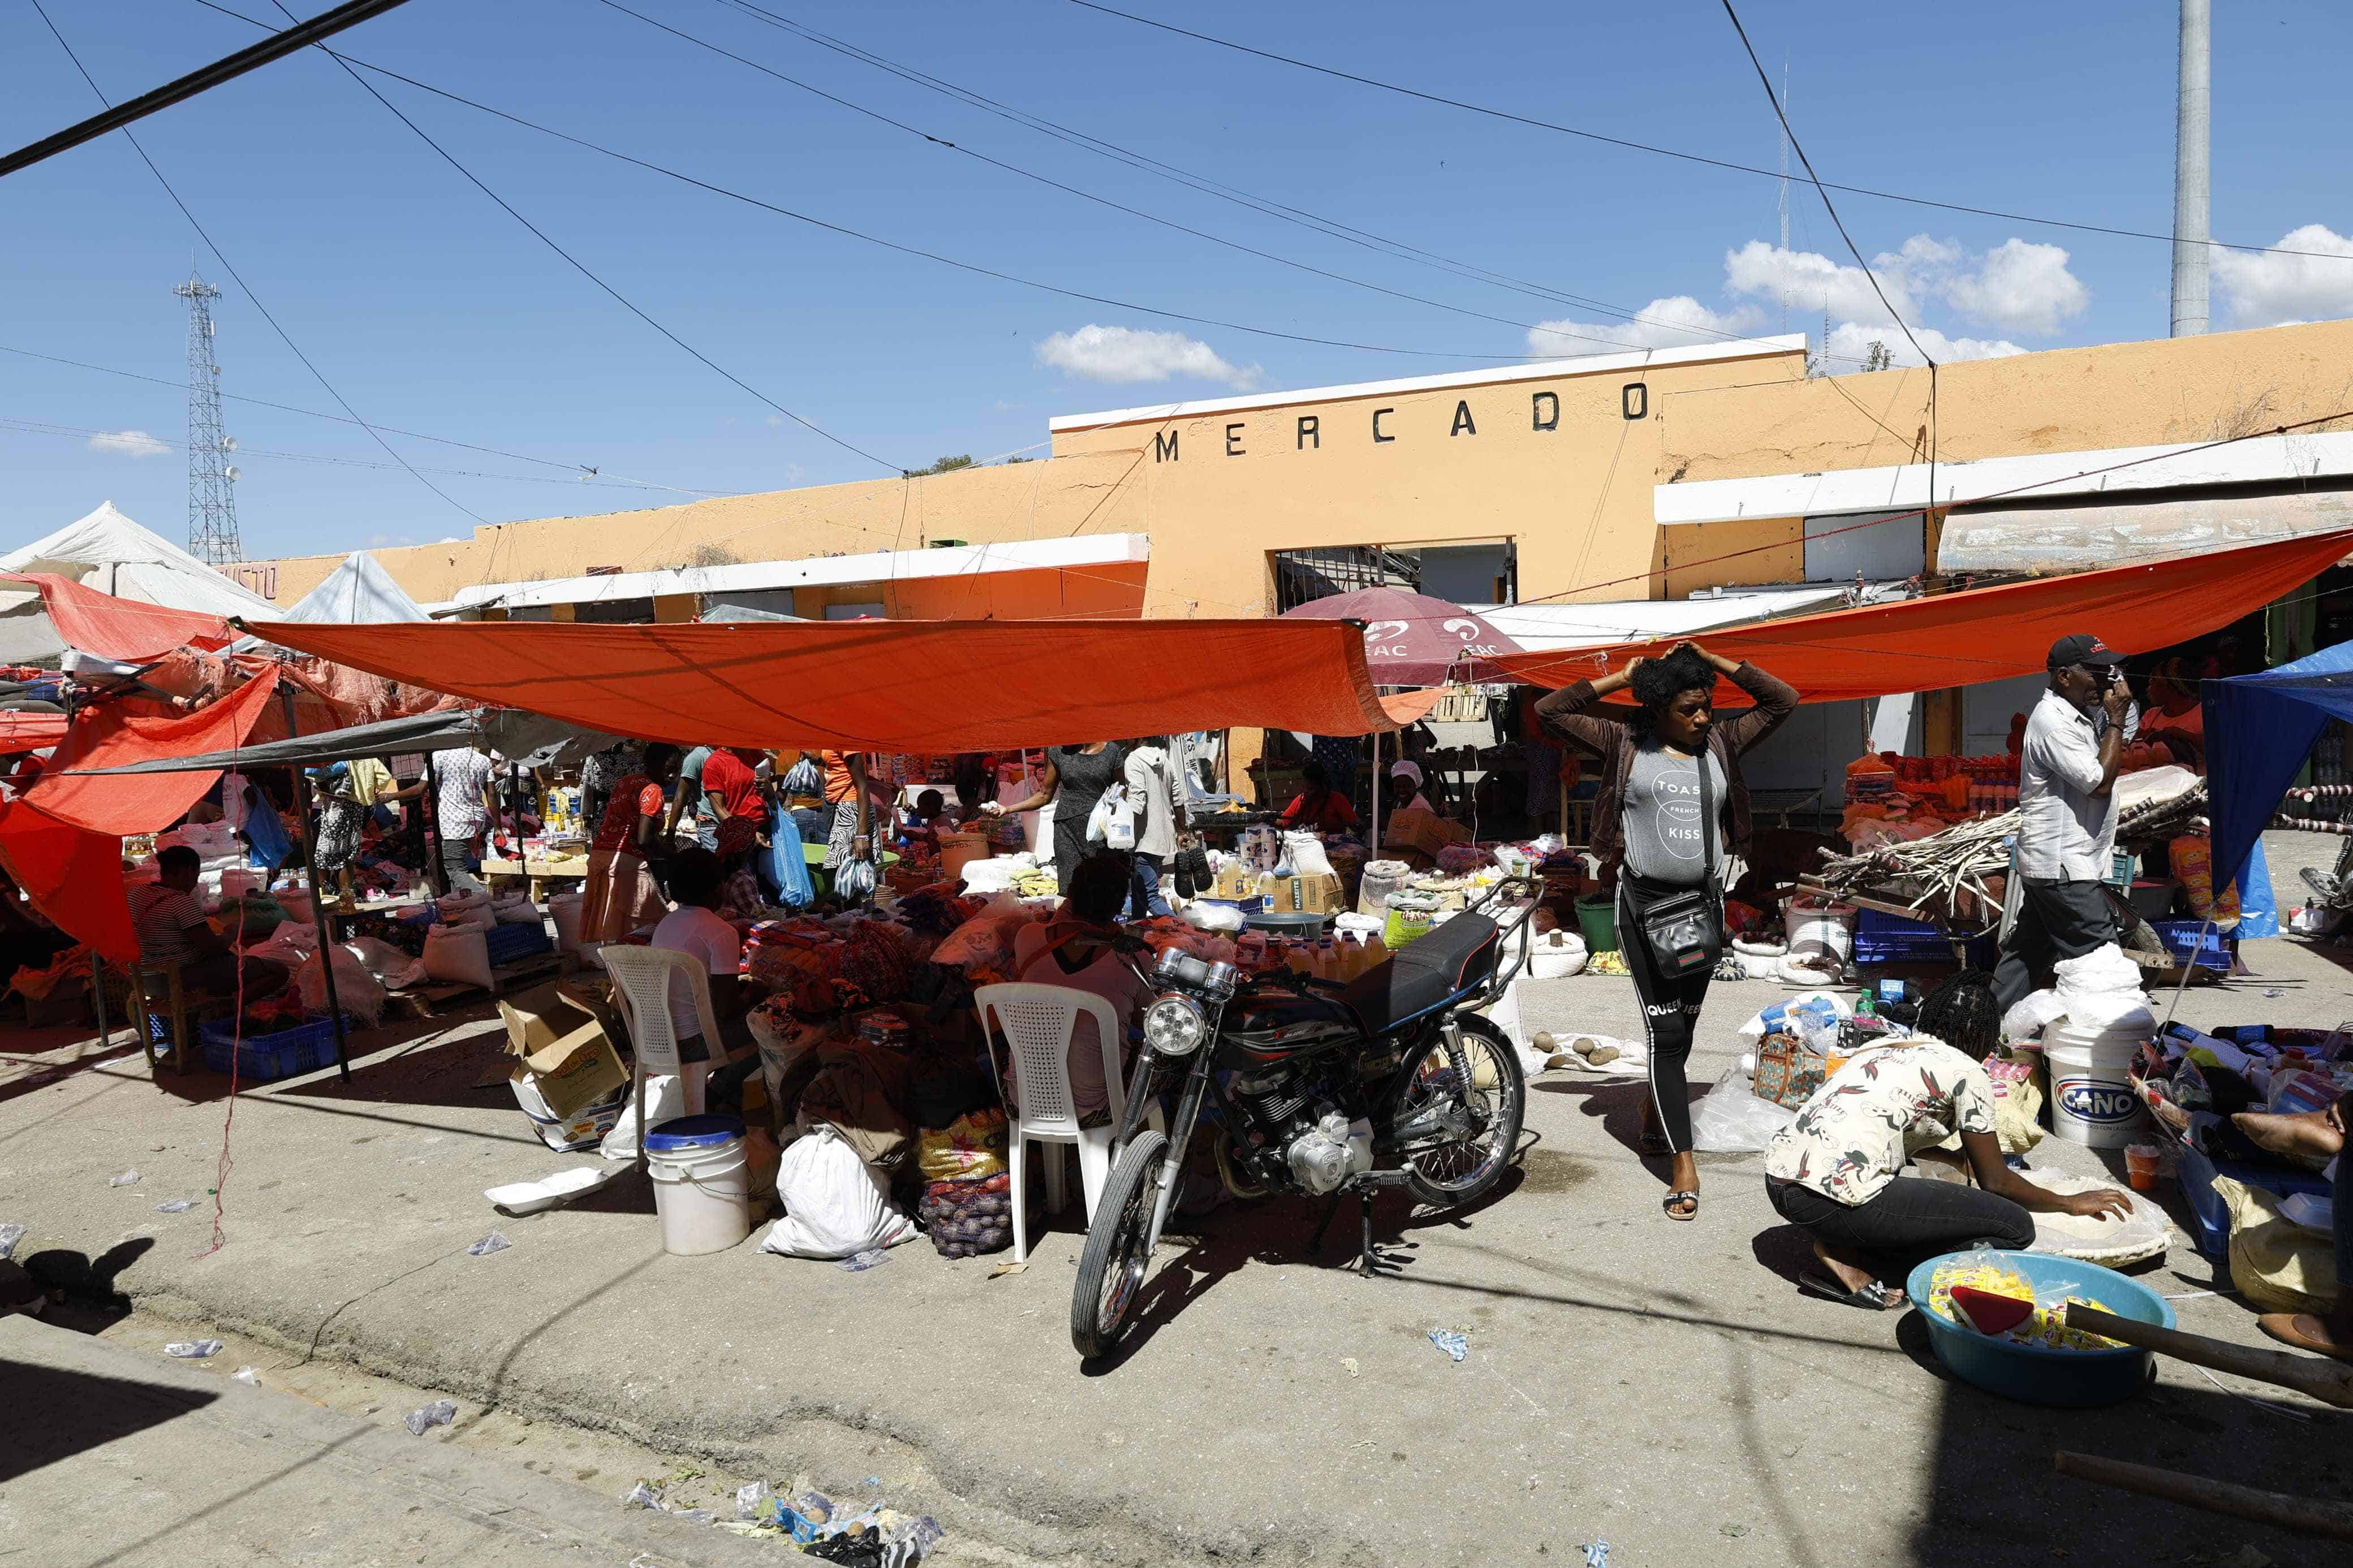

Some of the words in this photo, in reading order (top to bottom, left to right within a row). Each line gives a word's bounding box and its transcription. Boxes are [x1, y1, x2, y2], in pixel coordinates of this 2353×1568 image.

[1156, 382, 1648, 464] MERCADO
[1658, 780, 1700, 795] TOAS
[1669, 827, 1700, 839] KISS
[1647, 997, 1682, 1016] QUEEN
[2063, 1090, 2133, 1114] CANO
